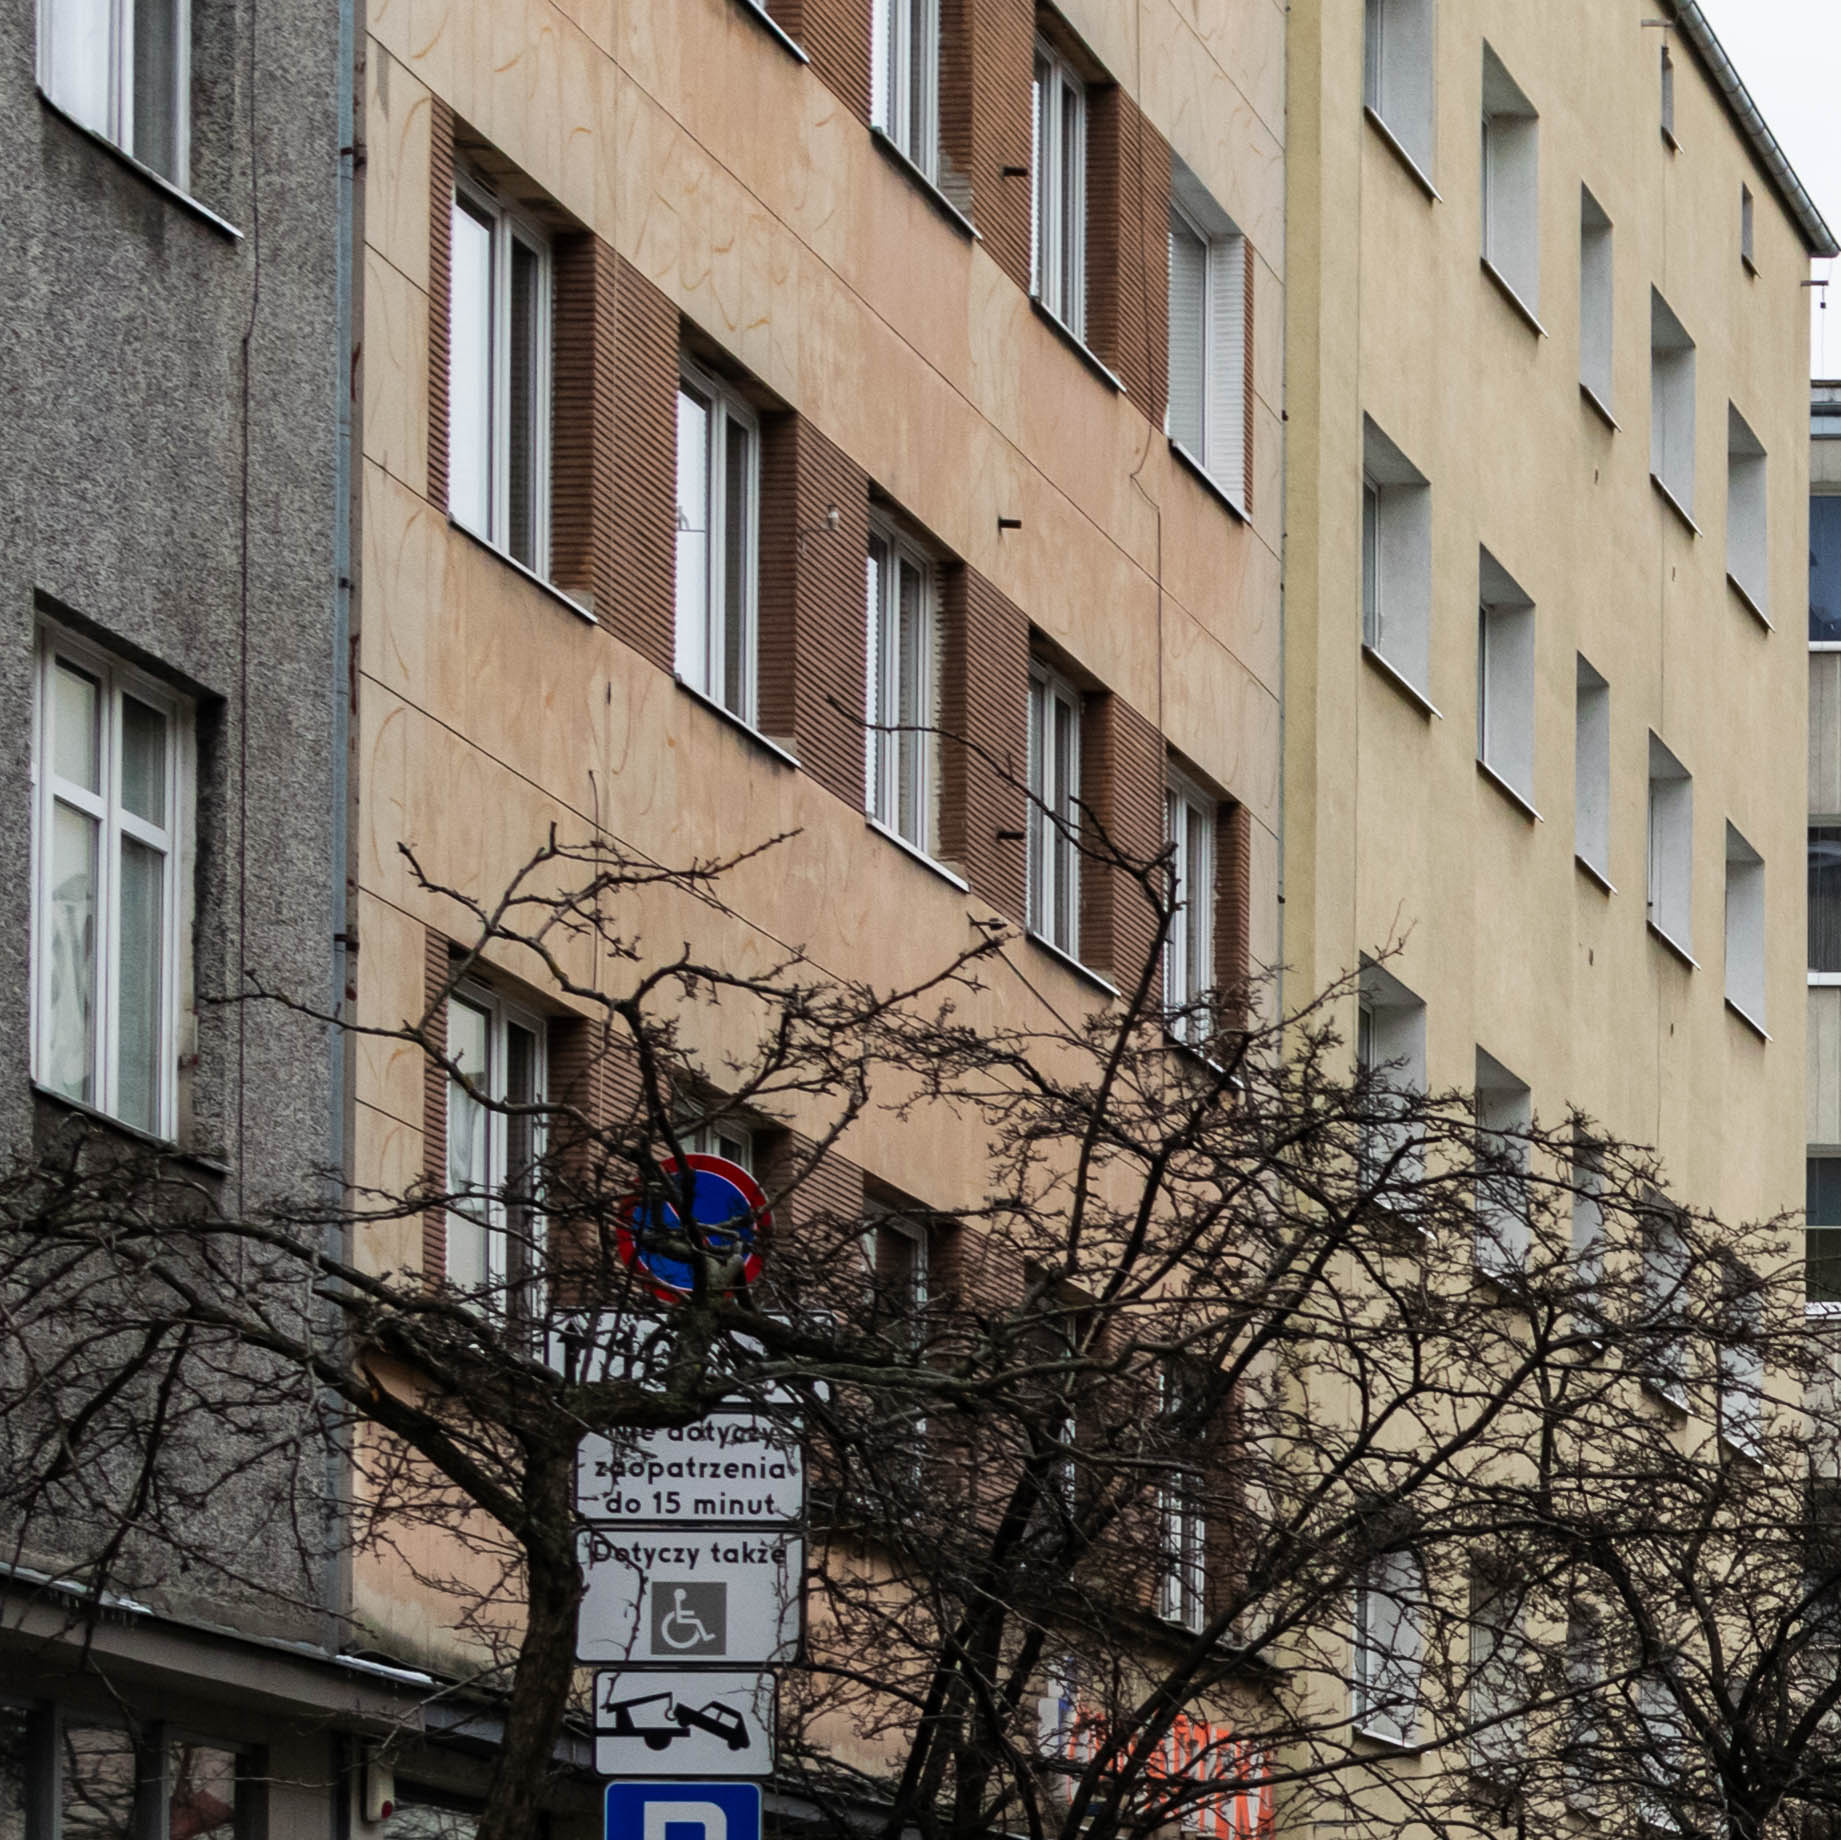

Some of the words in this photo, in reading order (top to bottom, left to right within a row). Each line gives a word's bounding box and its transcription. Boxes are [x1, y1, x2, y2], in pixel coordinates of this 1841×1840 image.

[594, 1456, 786, 1484] zaopatrzenia
[605, 1491, 642, 1514] do
[652, 1491, 681, 1514] 15
[693, 1492, 775, 1515] minut
[592, 1540, 699, 1569] Dotyczy
[711, 1540, 787, 1563] także
